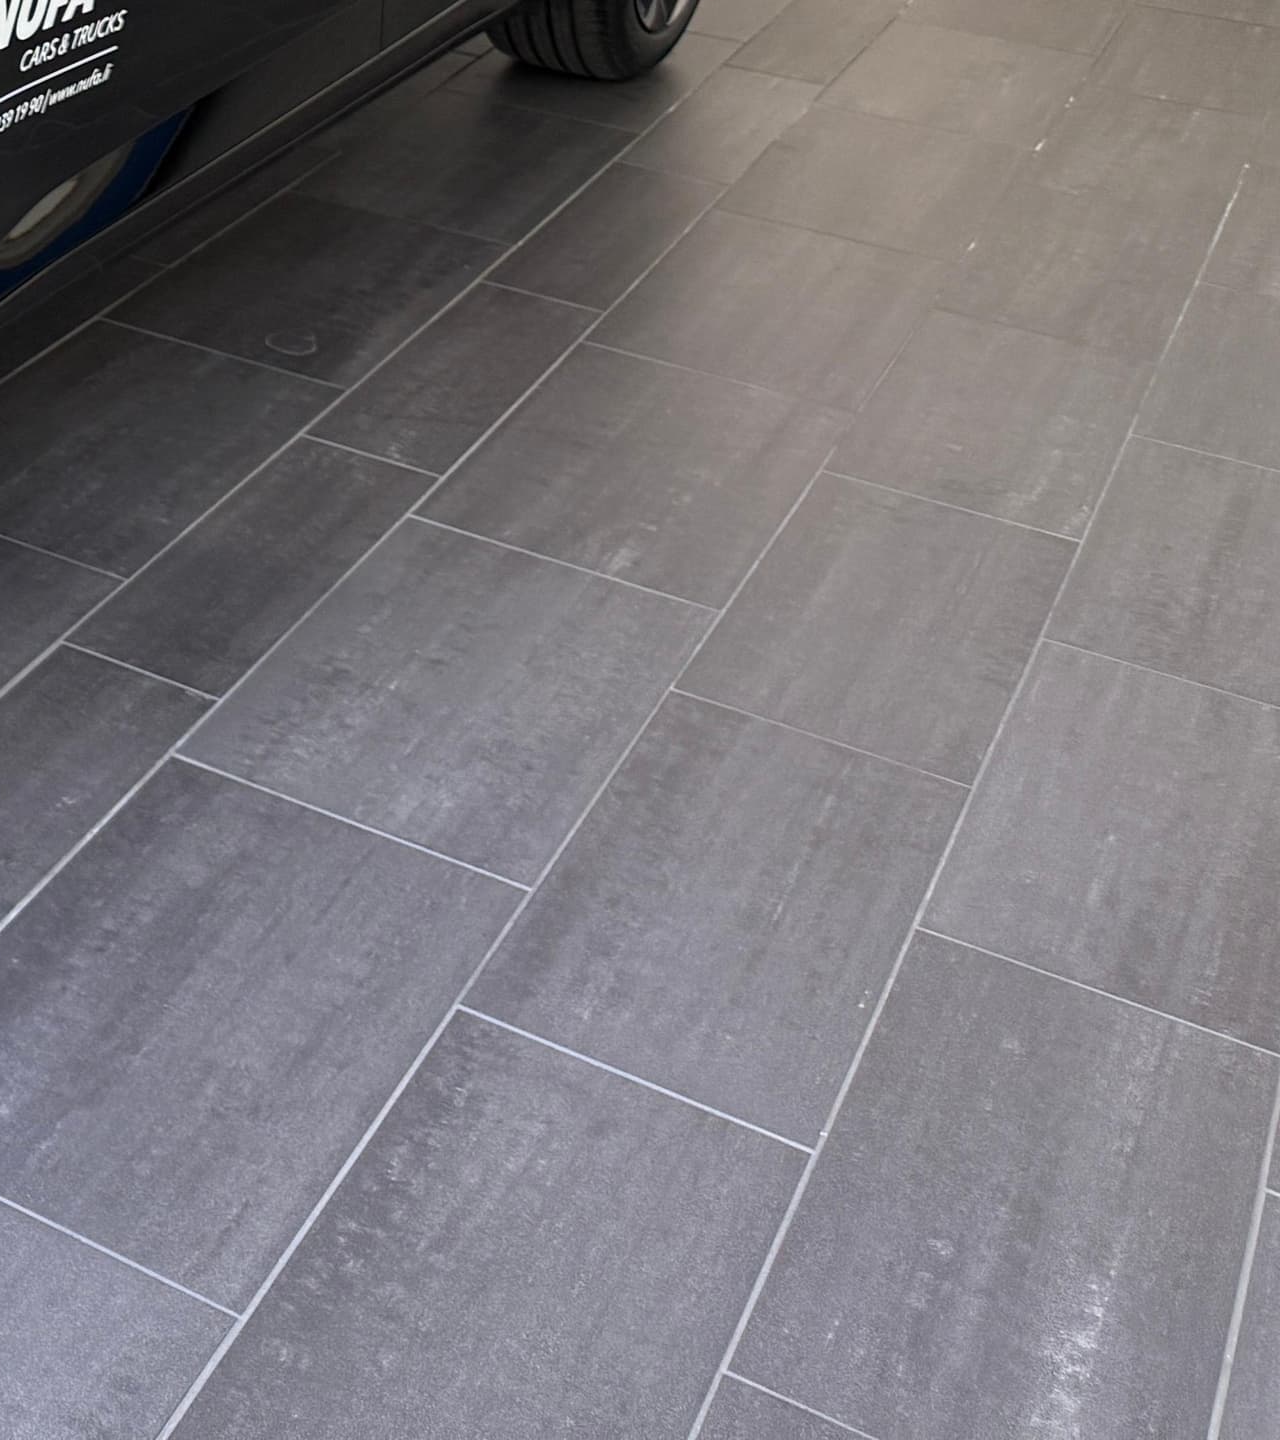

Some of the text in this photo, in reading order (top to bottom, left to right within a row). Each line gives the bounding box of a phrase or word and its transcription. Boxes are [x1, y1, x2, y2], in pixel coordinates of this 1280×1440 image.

[20, 9, 128, 72] CARS & TRUCKS
